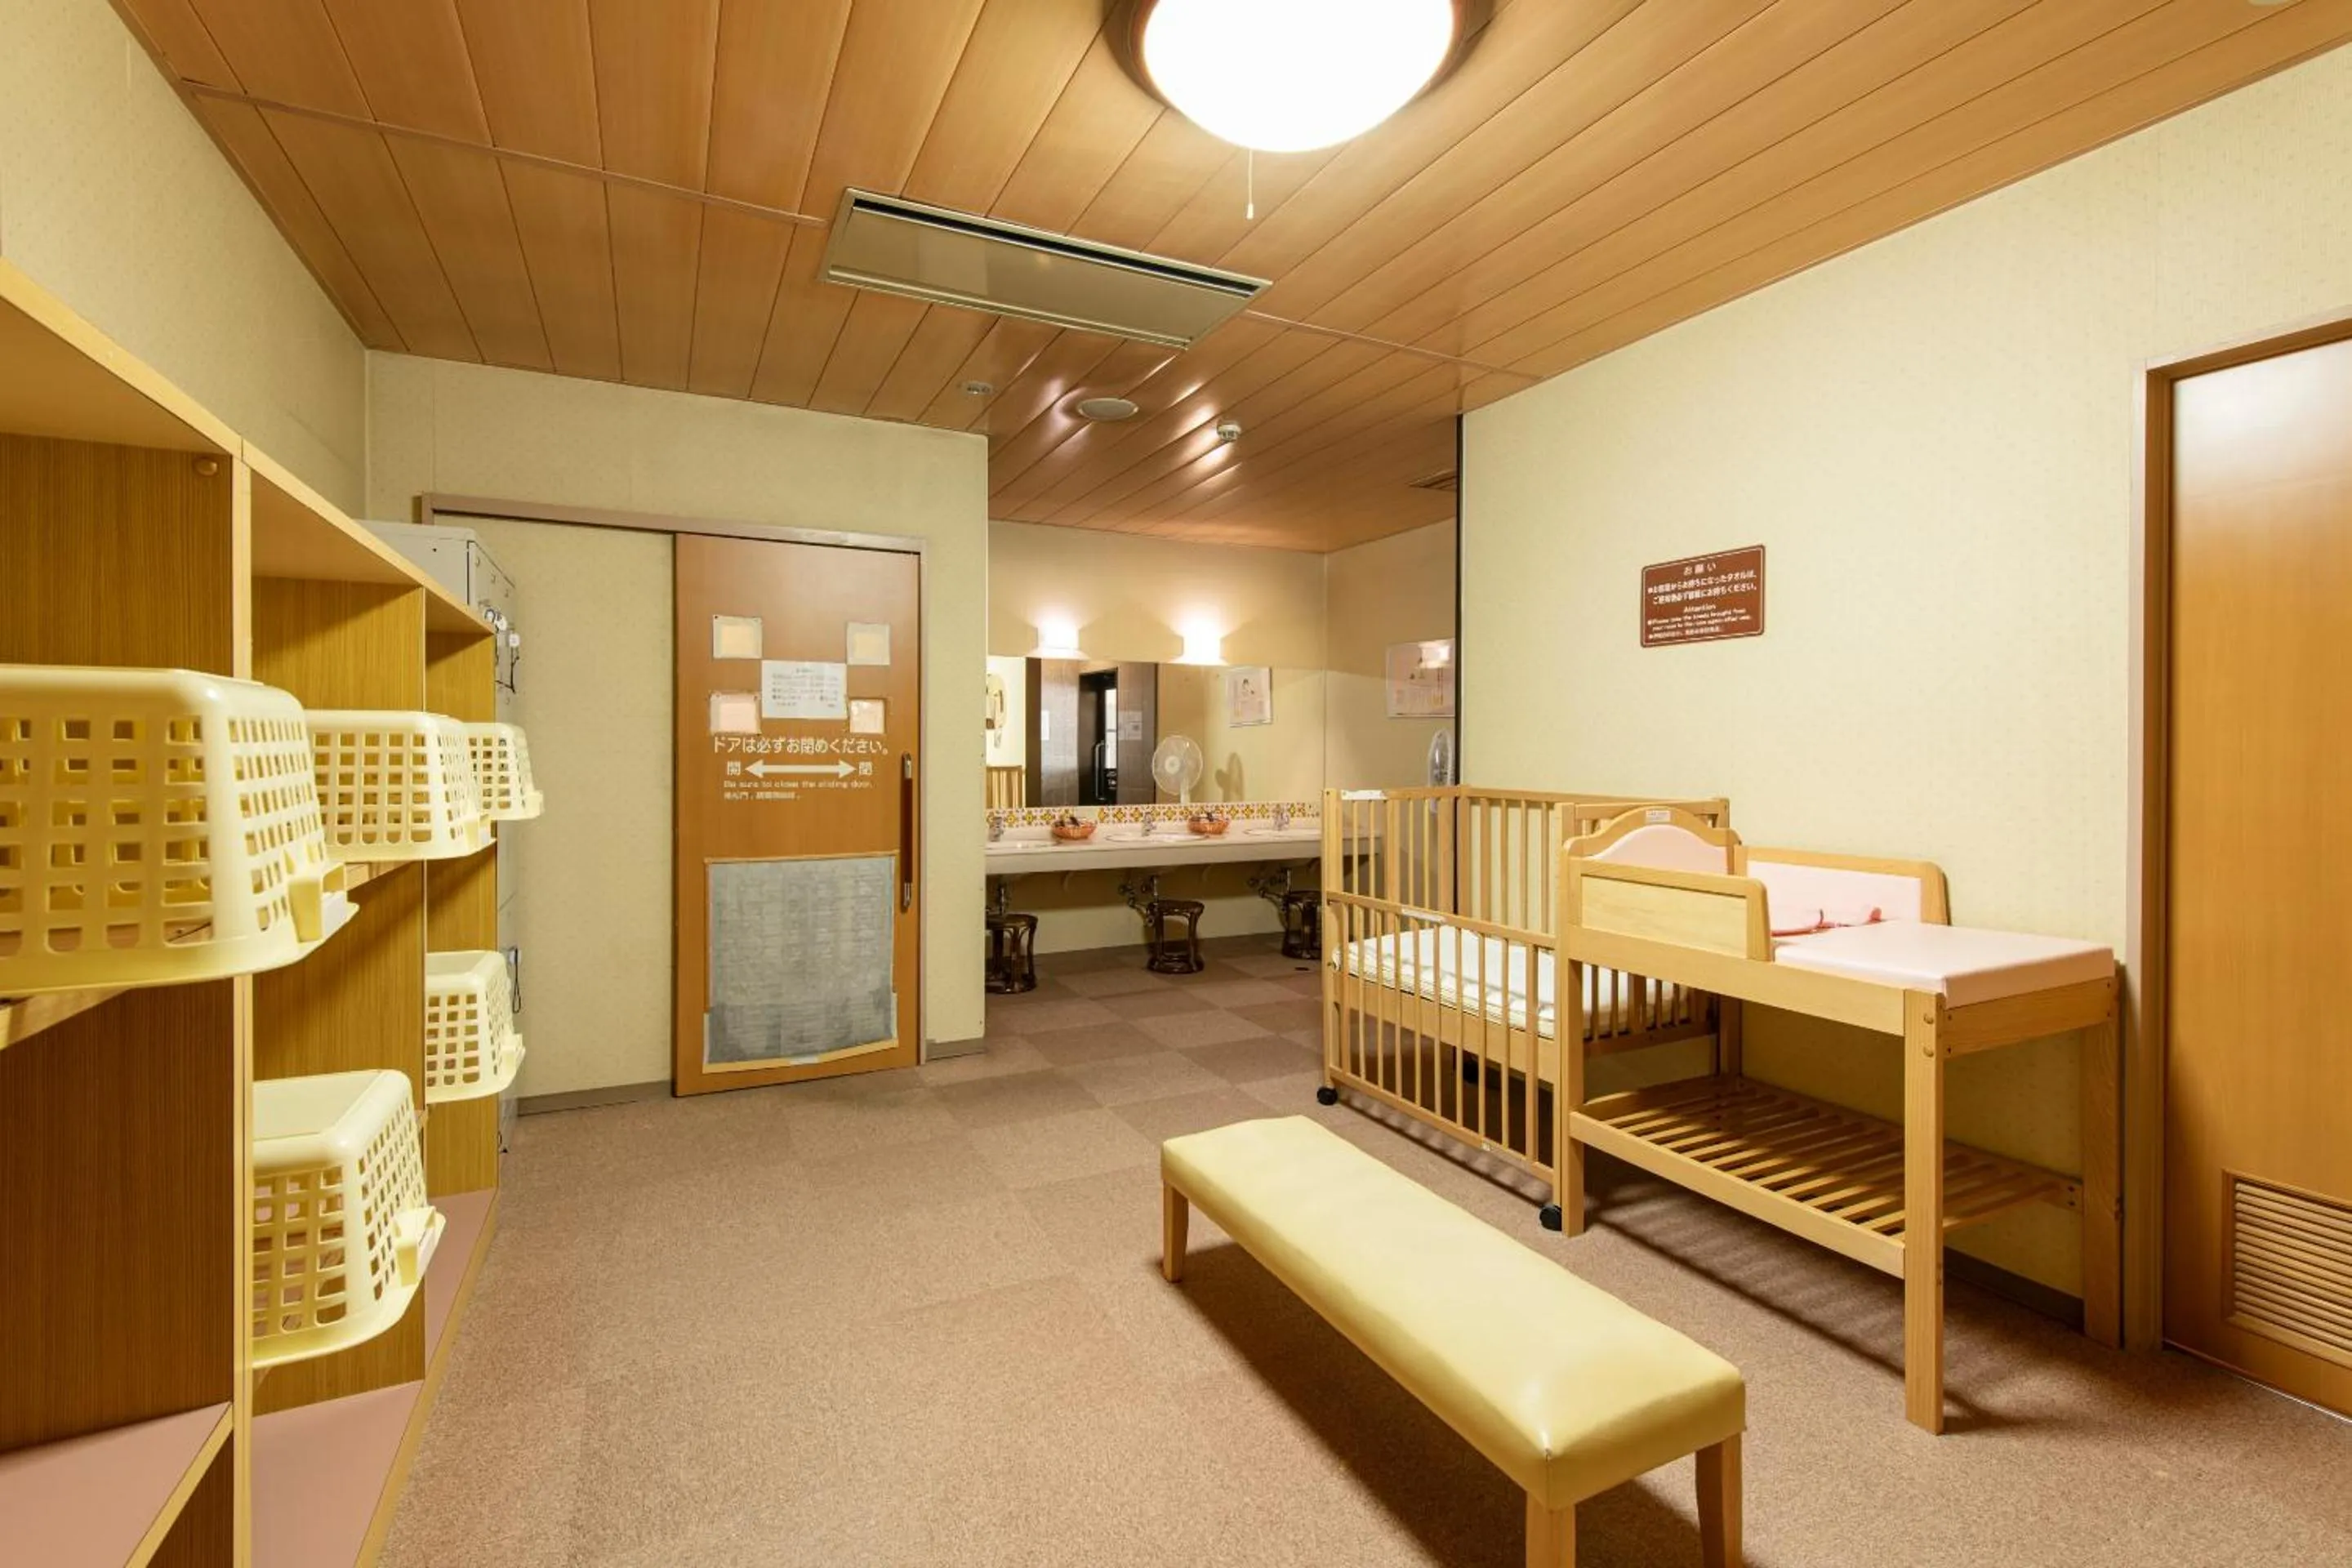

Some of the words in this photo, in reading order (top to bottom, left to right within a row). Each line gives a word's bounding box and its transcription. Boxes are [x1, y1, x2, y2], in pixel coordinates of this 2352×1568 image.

[1684, 562, 1717, 576] お願い
[714, 736, 889, 755] ドアは必ずお閉めください。
[727, 761, 741, 776] 開
[858, 761, 873, 776] 閉
